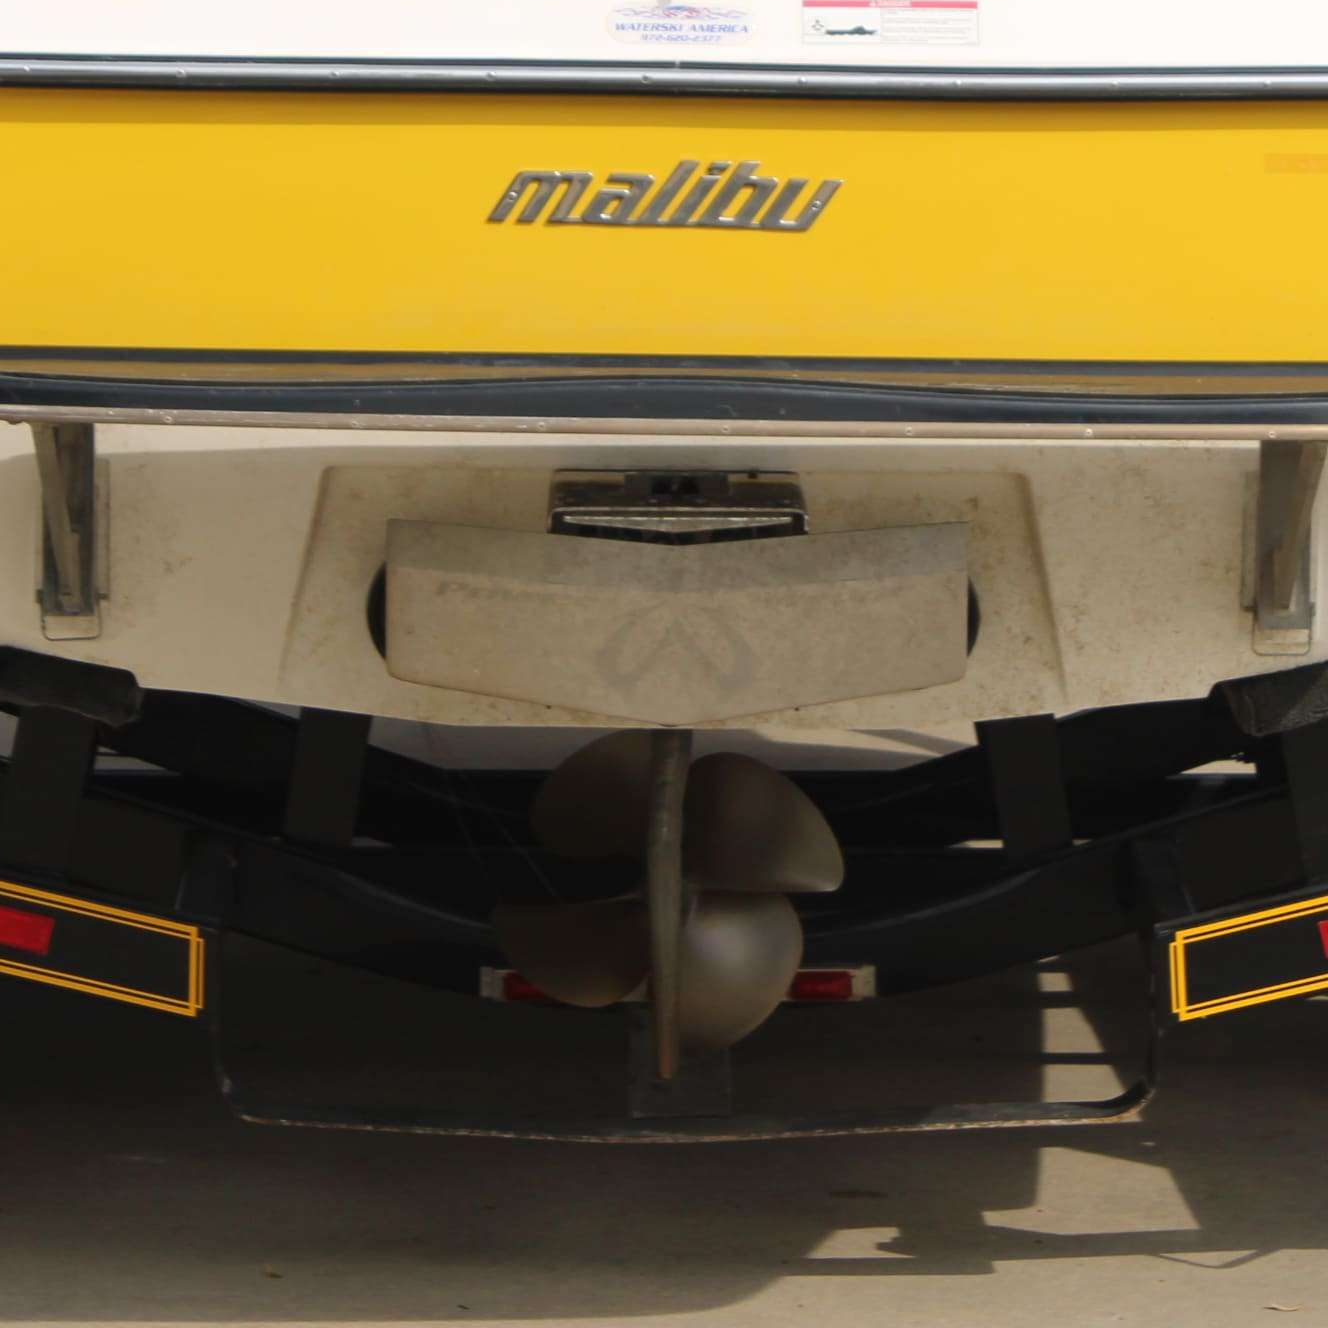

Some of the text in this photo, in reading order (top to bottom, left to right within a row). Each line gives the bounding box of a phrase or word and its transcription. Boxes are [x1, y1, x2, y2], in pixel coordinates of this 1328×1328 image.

[615, 23, 749, 34] WATERSKI AMERICA
[486, 159, 845, 233] malibu
